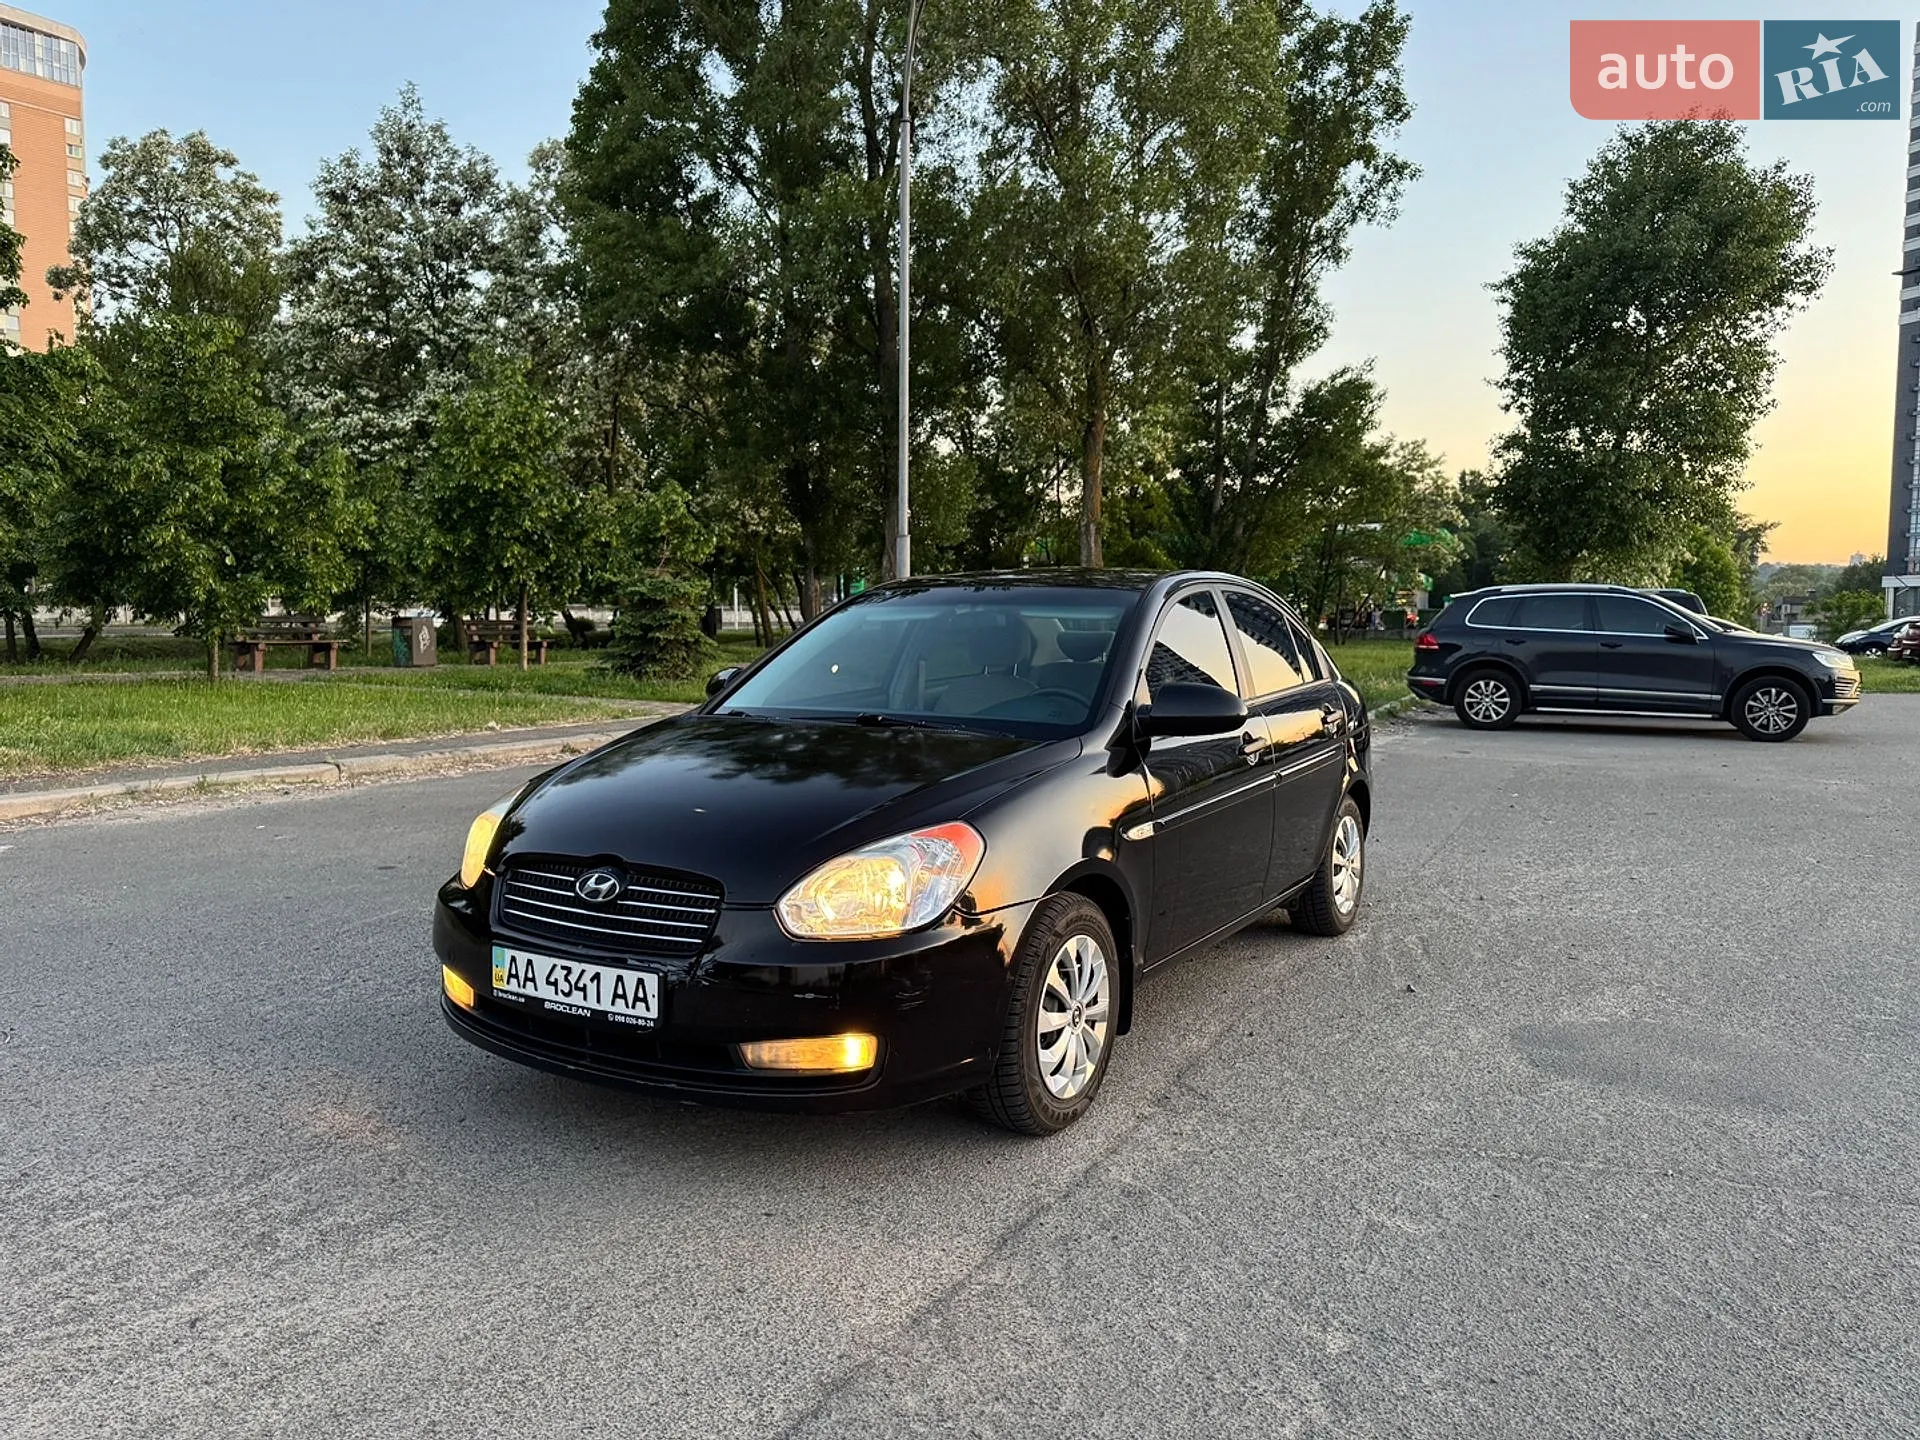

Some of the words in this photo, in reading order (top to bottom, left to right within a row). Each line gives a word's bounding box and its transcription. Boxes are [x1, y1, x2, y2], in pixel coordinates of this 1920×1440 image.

[494, 970, 504, 984] UA
[506, 954, 538, 992] AA
[545, 963, 602, 1007] 4341
[611, 974, 650, 1012] AA
[544, 1001, 591, 1017] BROCLEAN
